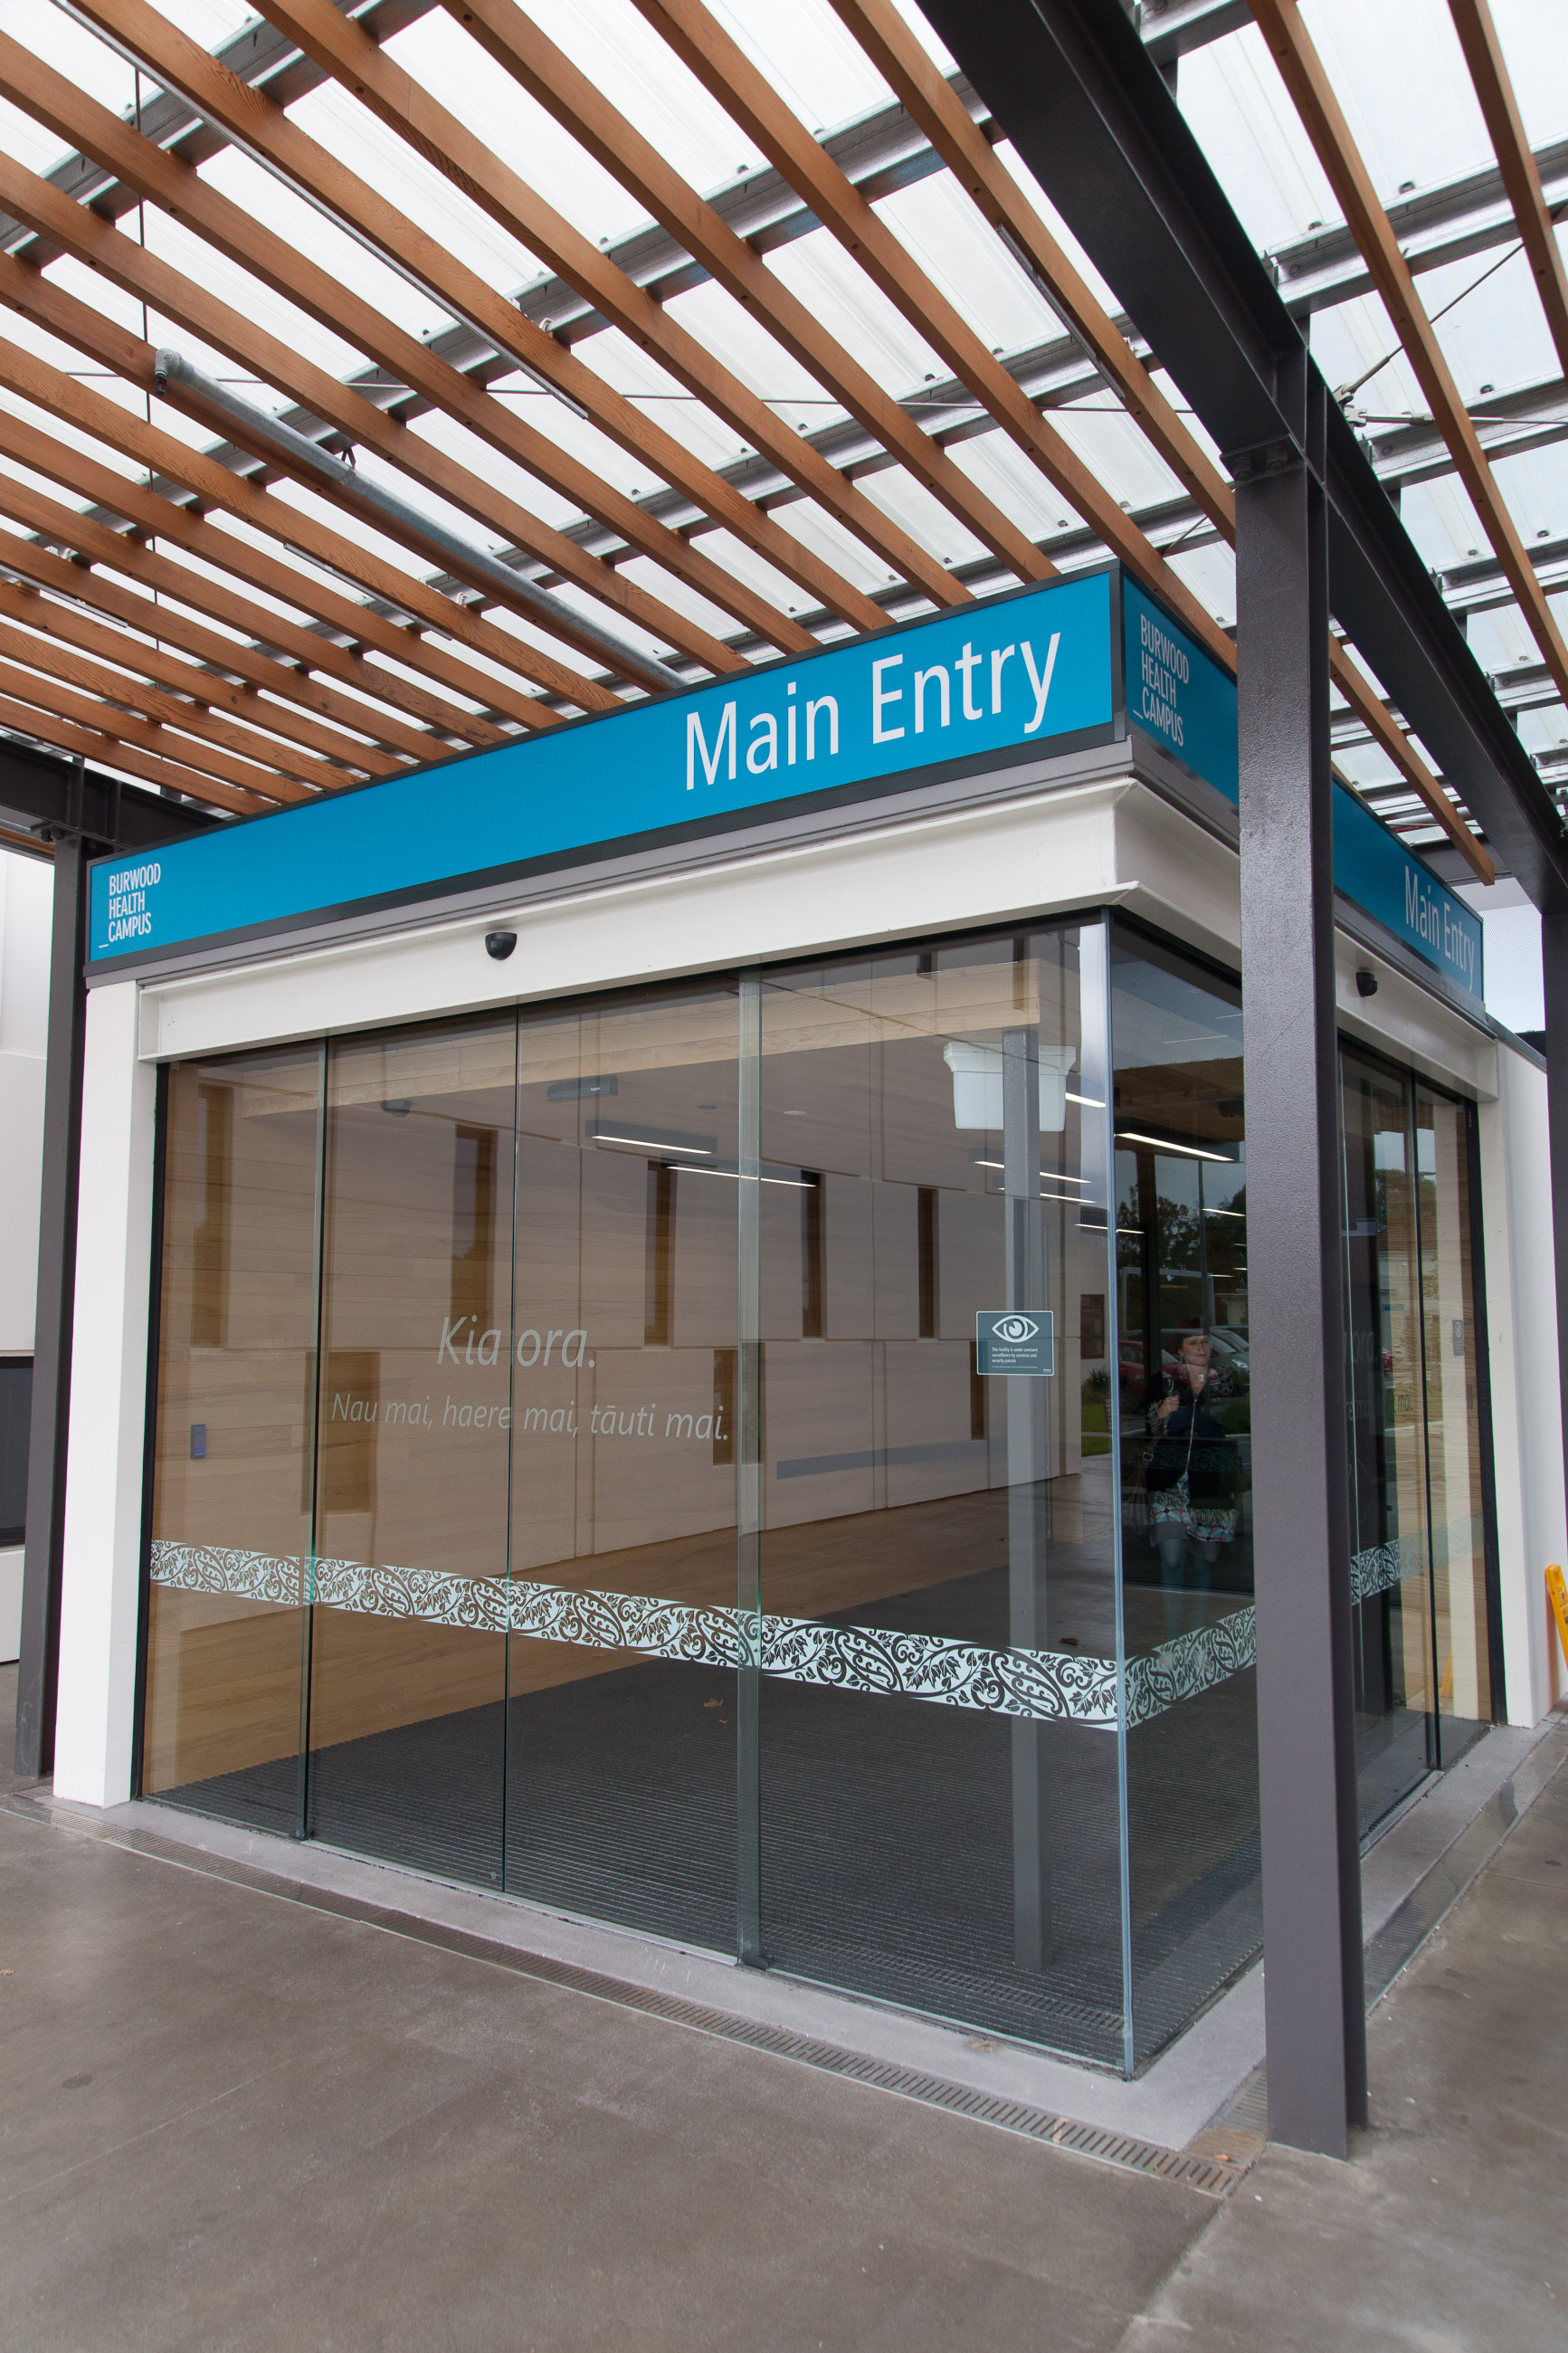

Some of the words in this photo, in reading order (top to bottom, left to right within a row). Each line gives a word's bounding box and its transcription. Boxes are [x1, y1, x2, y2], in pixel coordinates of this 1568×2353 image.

[1140, 613, 1190, 684] BURWOOD
[1141, 650, 1177, 709] HEALTH
[685, 681, 840, 791] Main
[871, 632, 1060, 734] Entry
[109, 862, 161, 897] BURWOOD
[109, 890, 146, 919] HEALTH
[1405, 864, 1440, 950] Main
[1443, 901, 1475, 992] Entry
[437, 1314, 502, 1366] Kia
[517, 1327, 596, 1368] ora.
[331, 1392, 377, 1423] Nau
[385, 1395, 433, 1431] mai,
[442, 1395, 513, 1428] haere
[523, 1400, 580, 1438] mai,
[590, 1403, 656, 1437] tāuti
[664, 1405, 728, 1441] mai.
